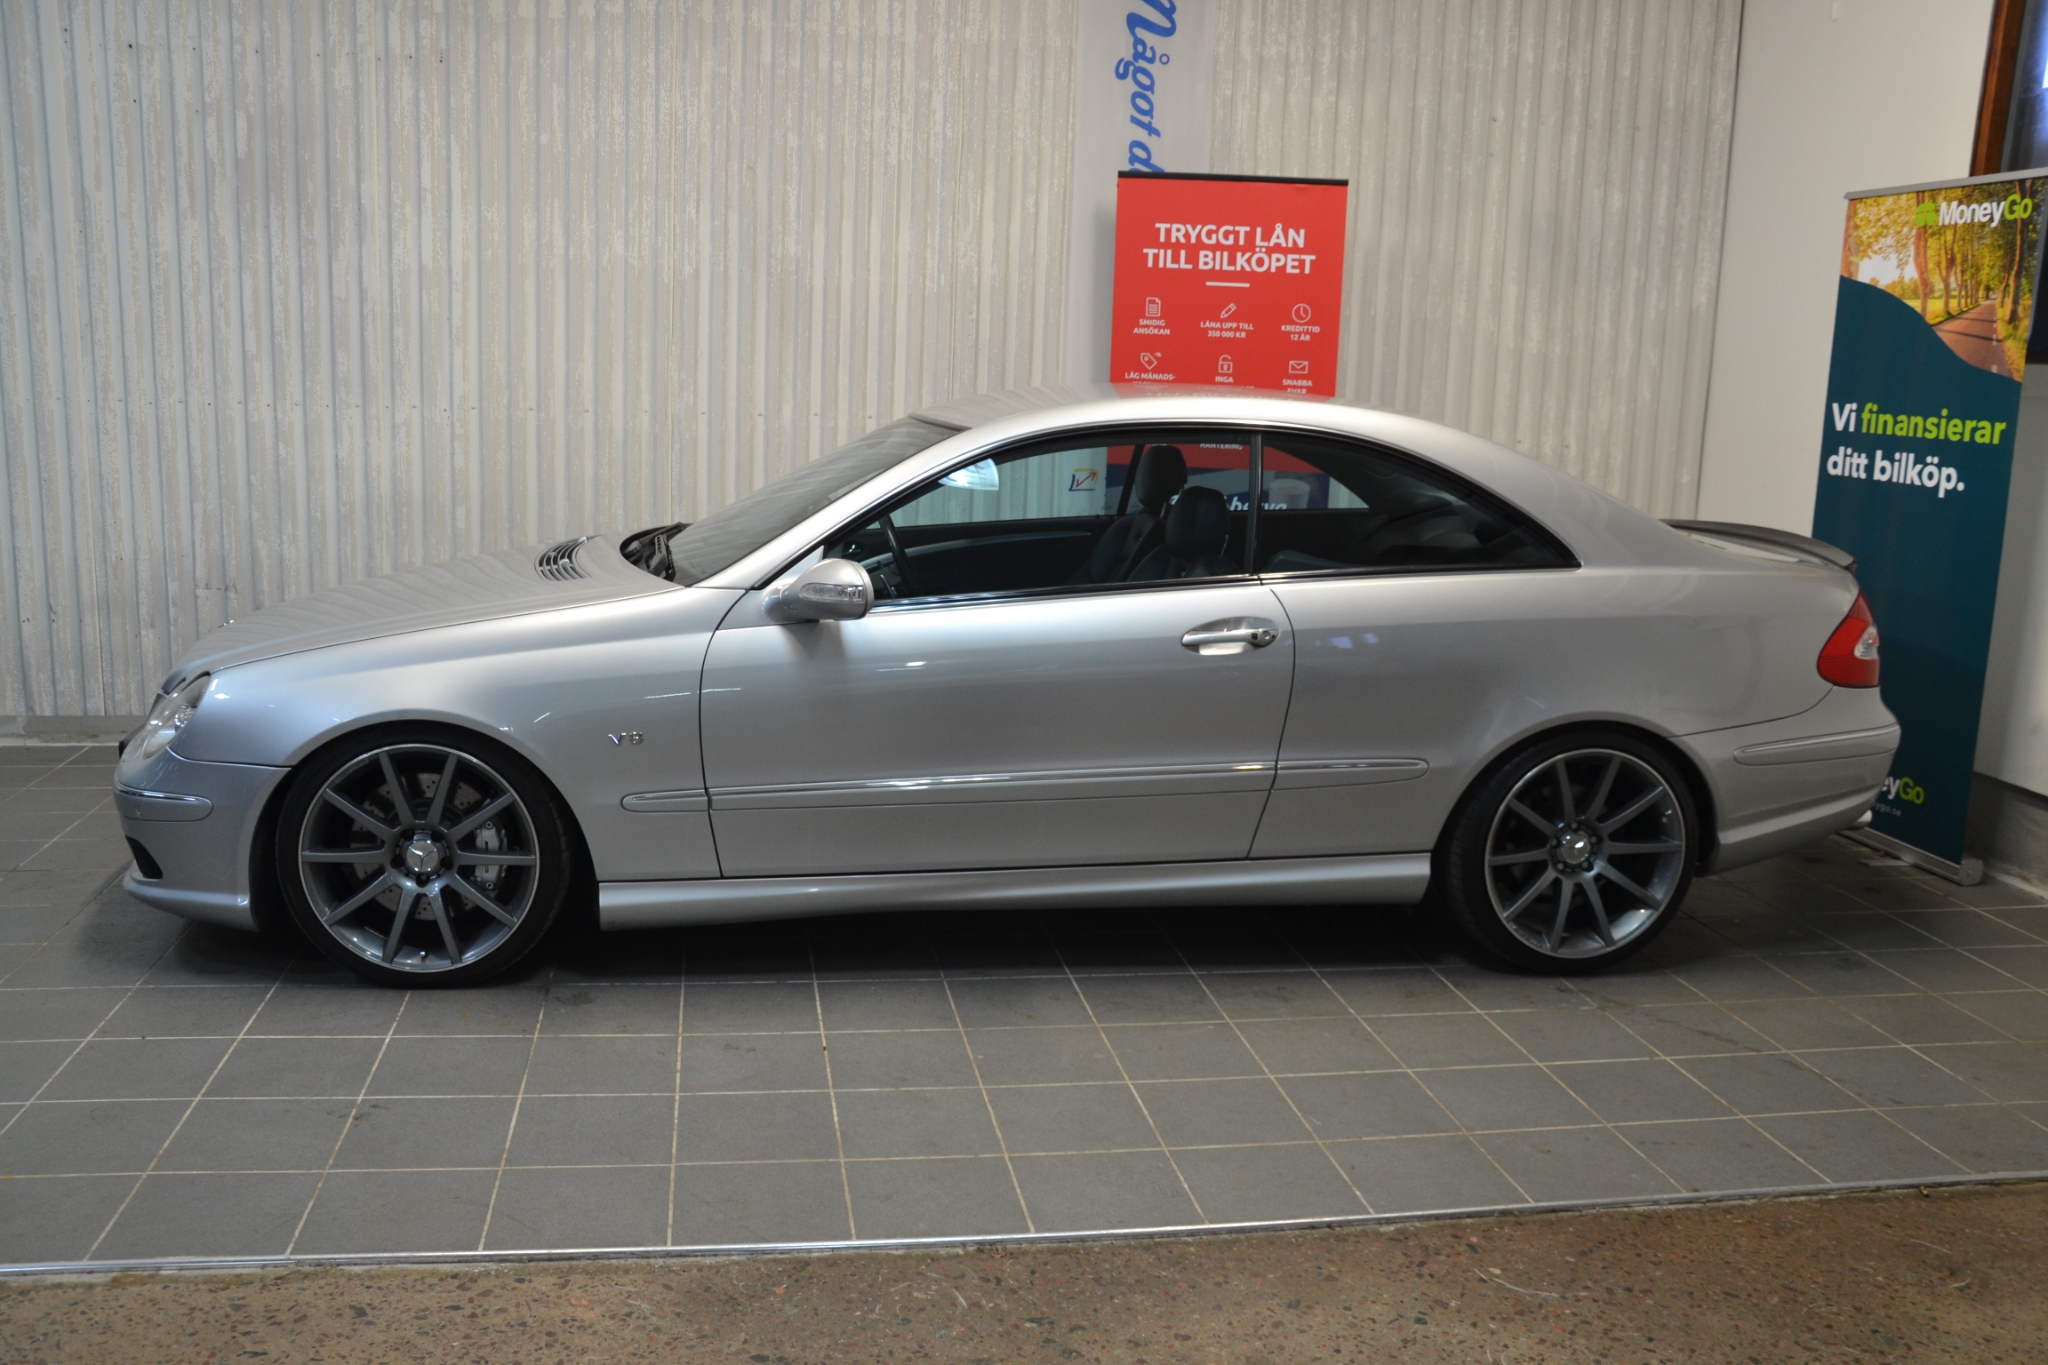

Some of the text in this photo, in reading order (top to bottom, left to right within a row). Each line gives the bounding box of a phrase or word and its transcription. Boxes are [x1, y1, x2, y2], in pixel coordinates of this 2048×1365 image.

[1128, 139, 1165, 172] d
[1938, 193, 2033, 228] MoneyGo
[1155, 223, 1305, 248] TRYGGT LÅN
[1143, 247, 1316, 274] TILL BILKÖPET
[1200, 320, 1221, 328] LÅNA
[1133, 326, 1170, 335] ANSÖKAN
[1281, 325, 1320, 333] KREDITTID
[1300, 333, 1311, 341] ÅR
[1125, 371, 1140, 379] LÅG
[1215, 375, 1234, 383] INGA
[1282, 379, 1313, 387] SNABBA
[1831, 402, 2006, 445] Vi finansierar
[1826, 446, 1965, 498] ditt bilköp.
